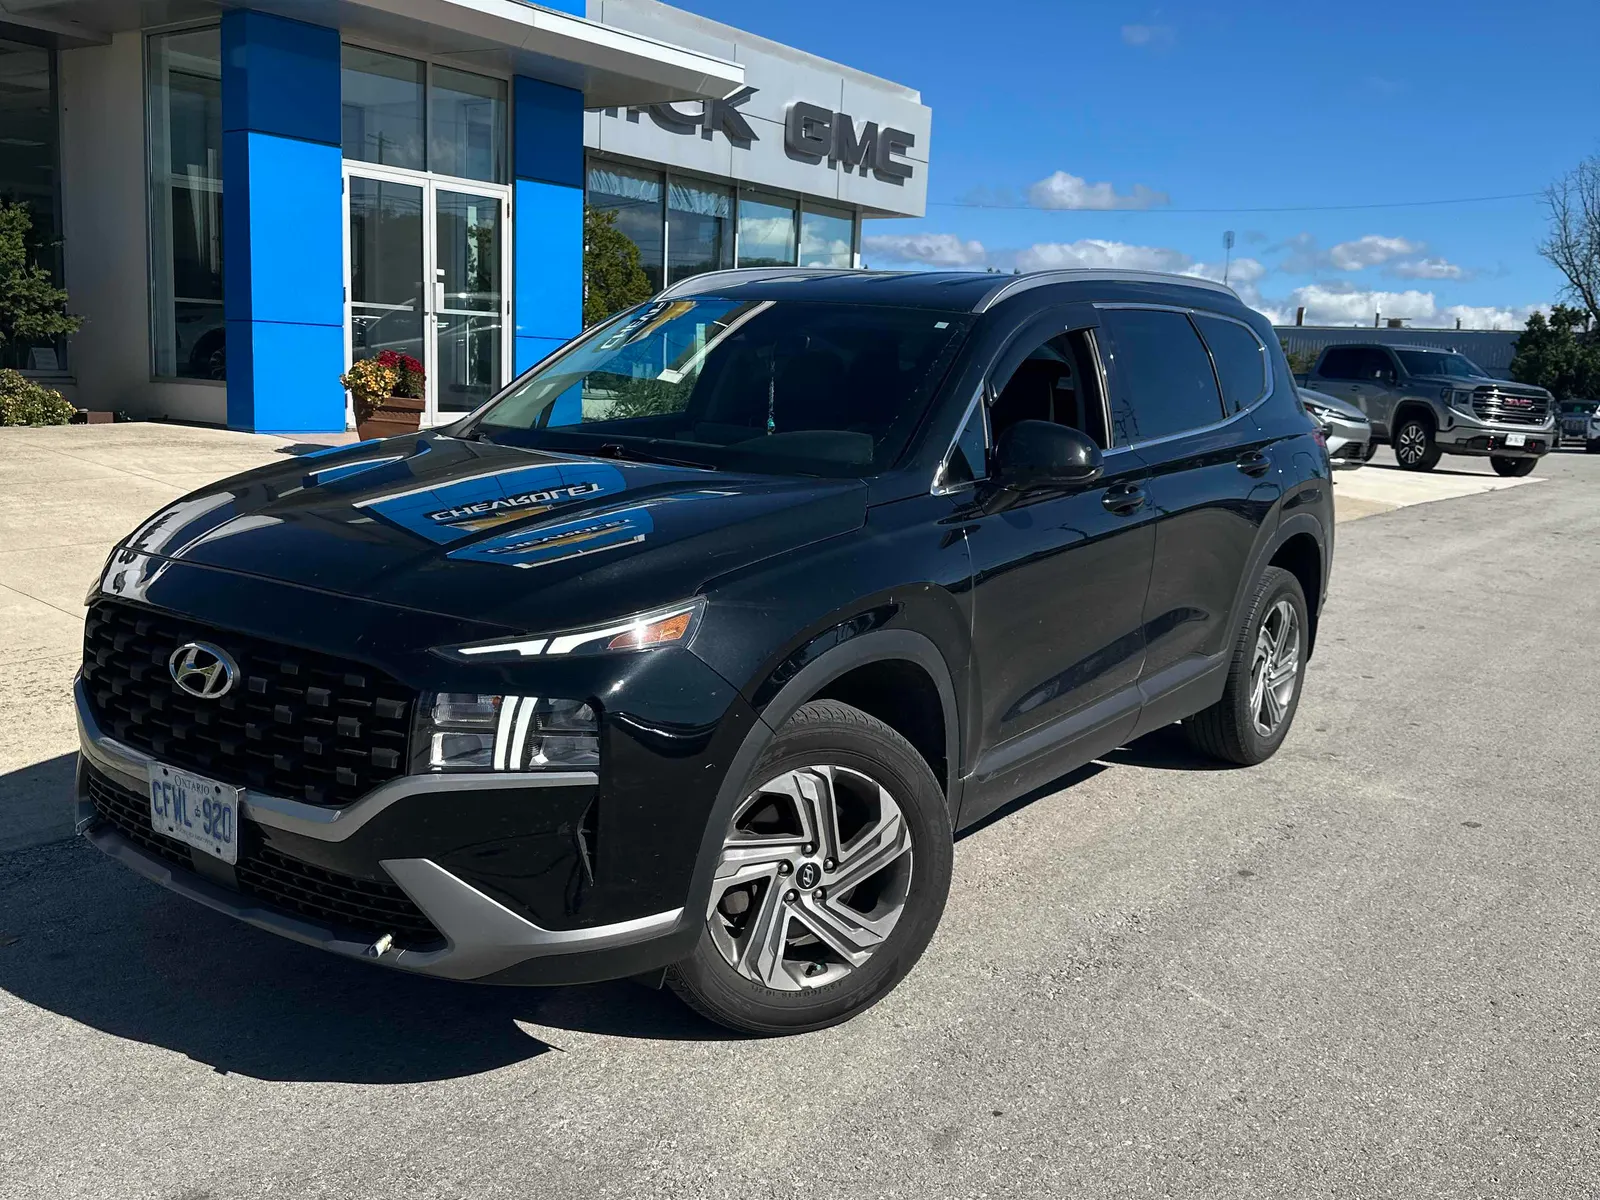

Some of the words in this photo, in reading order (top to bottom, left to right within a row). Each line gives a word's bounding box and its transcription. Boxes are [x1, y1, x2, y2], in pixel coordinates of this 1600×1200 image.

[784, 101, 915, 180] GMC
[152, 780, 192, 828] CFWL
[202, 797, 232, 844] 920
[175, 775, 210, 795] ONTARIO
